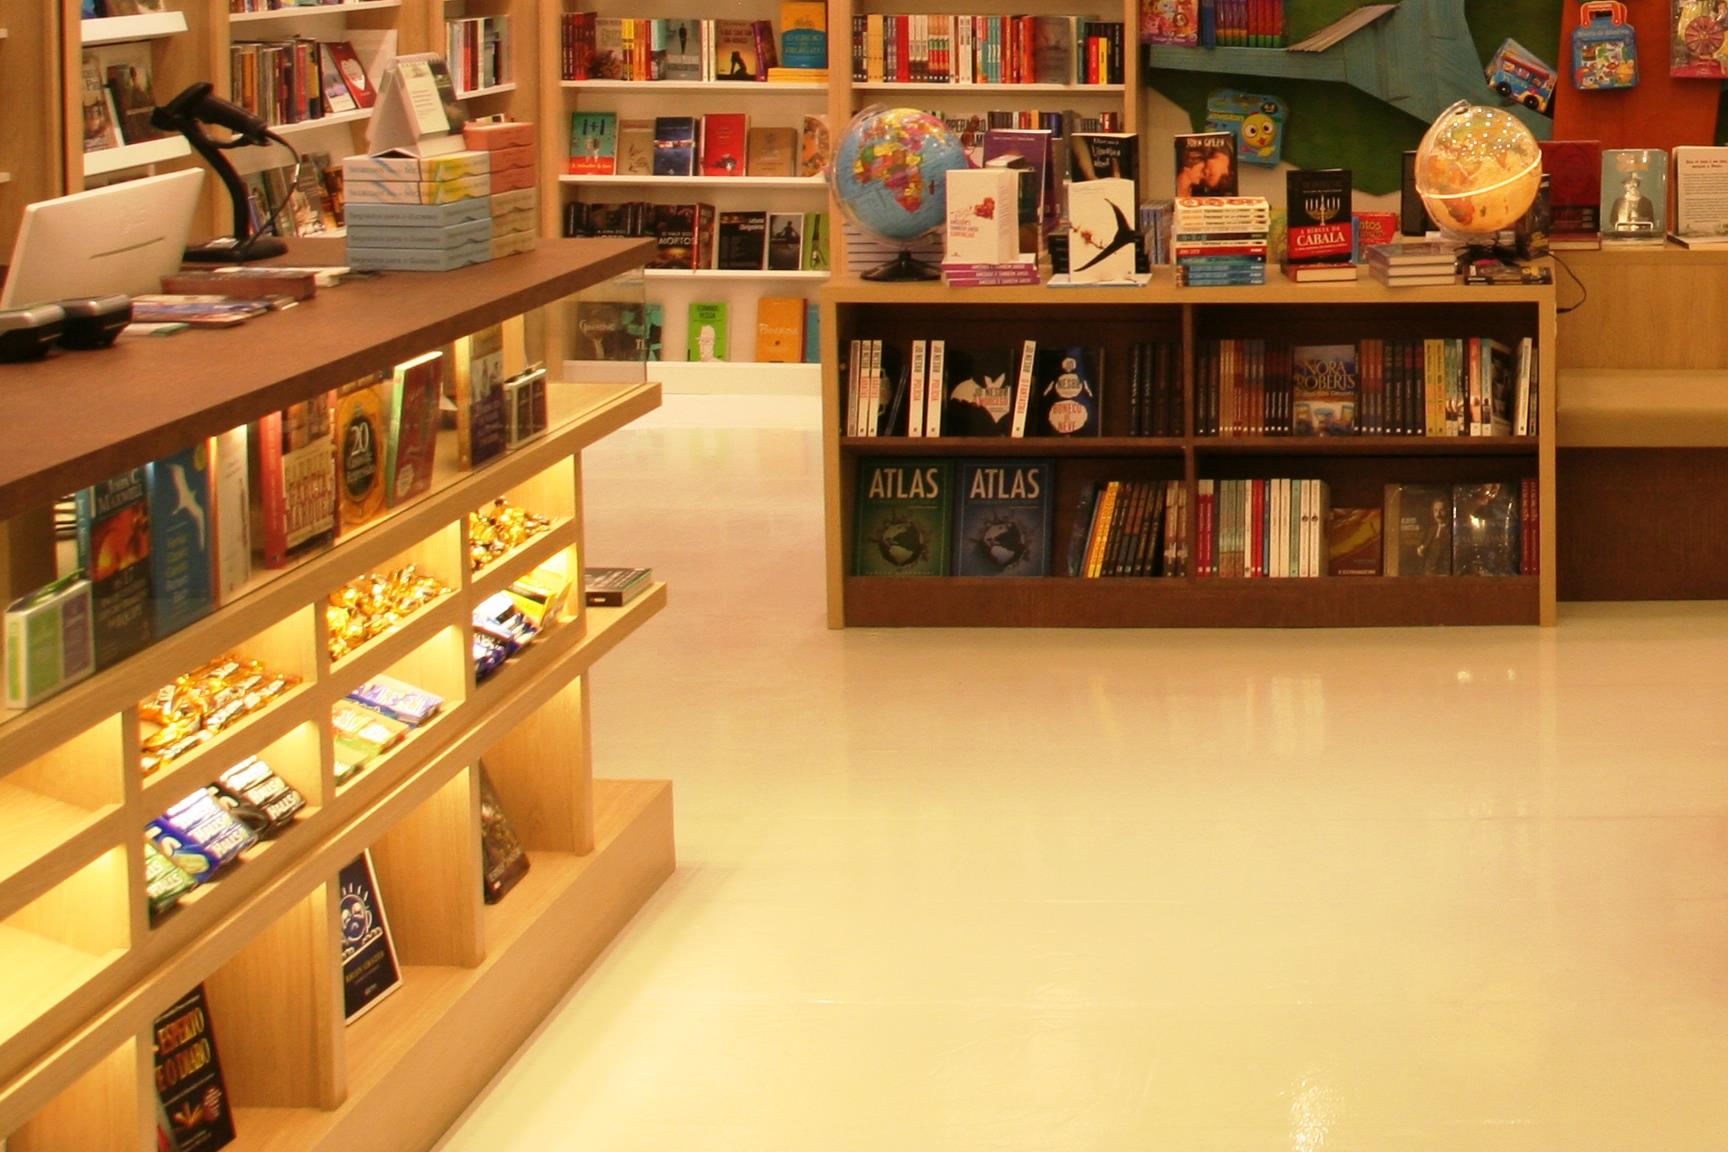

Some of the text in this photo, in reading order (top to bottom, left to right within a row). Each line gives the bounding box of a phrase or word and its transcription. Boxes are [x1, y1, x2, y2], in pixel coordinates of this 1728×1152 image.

[1296, 231, 1346, 247] CABALA
[1306, 360, 1347, 377] NORA
[1297, 374, 1356, 392] ROBERTS
[351, 422, 369, 457] 20
[868, 467, 940, 499] ATLAS
[970, 467, 1041, 499] ATLAS
